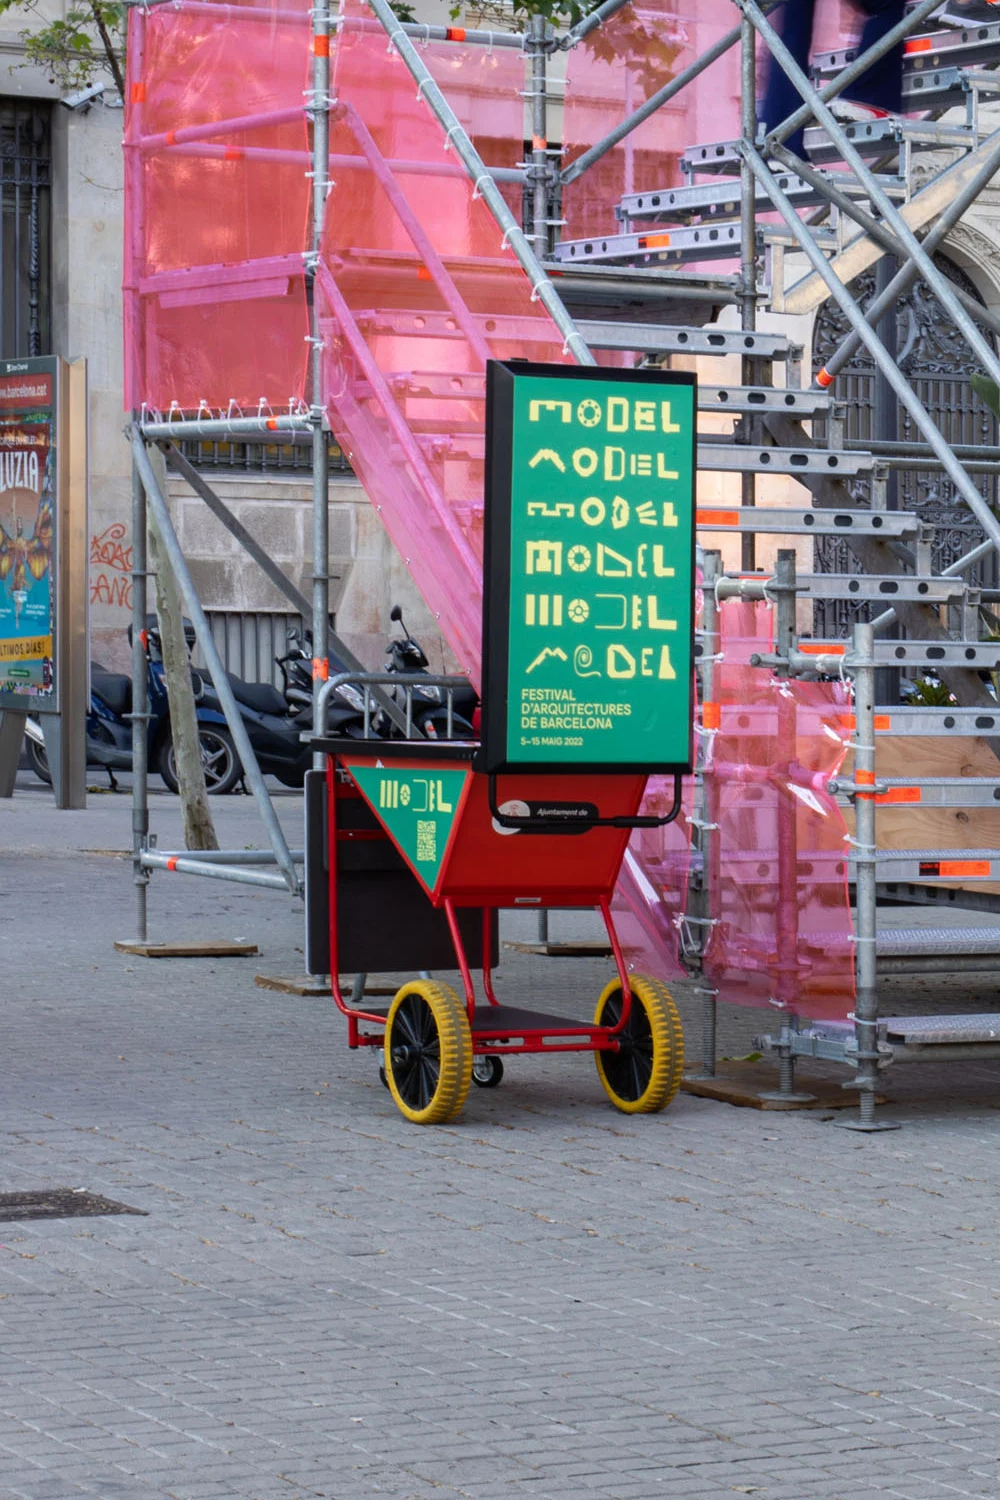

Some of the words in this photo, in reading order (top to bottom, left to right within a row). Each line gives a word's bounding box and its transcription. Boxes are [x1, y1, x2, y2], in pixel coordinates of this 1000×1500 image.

[529, 396, 680, 434] MODEL
[528, 446, 679, 481] MODEL
[0, 451, 39, 493] LUZIA
[526, 496, 678, 529] MODEL
[521, 688, 576, 701] FESTIVAL
[521, 703, 632, 716] D'ARQUITECTURES
[521, 717, 537, 729] DE
[540, 717, 613, 729] BARCELONA
[541, 736, 563, 746] MAIG
[563, 737, 584, 746] 2022
[537, 808, 578, 817] Ajuntament
[579, 808, 588, 816] de
